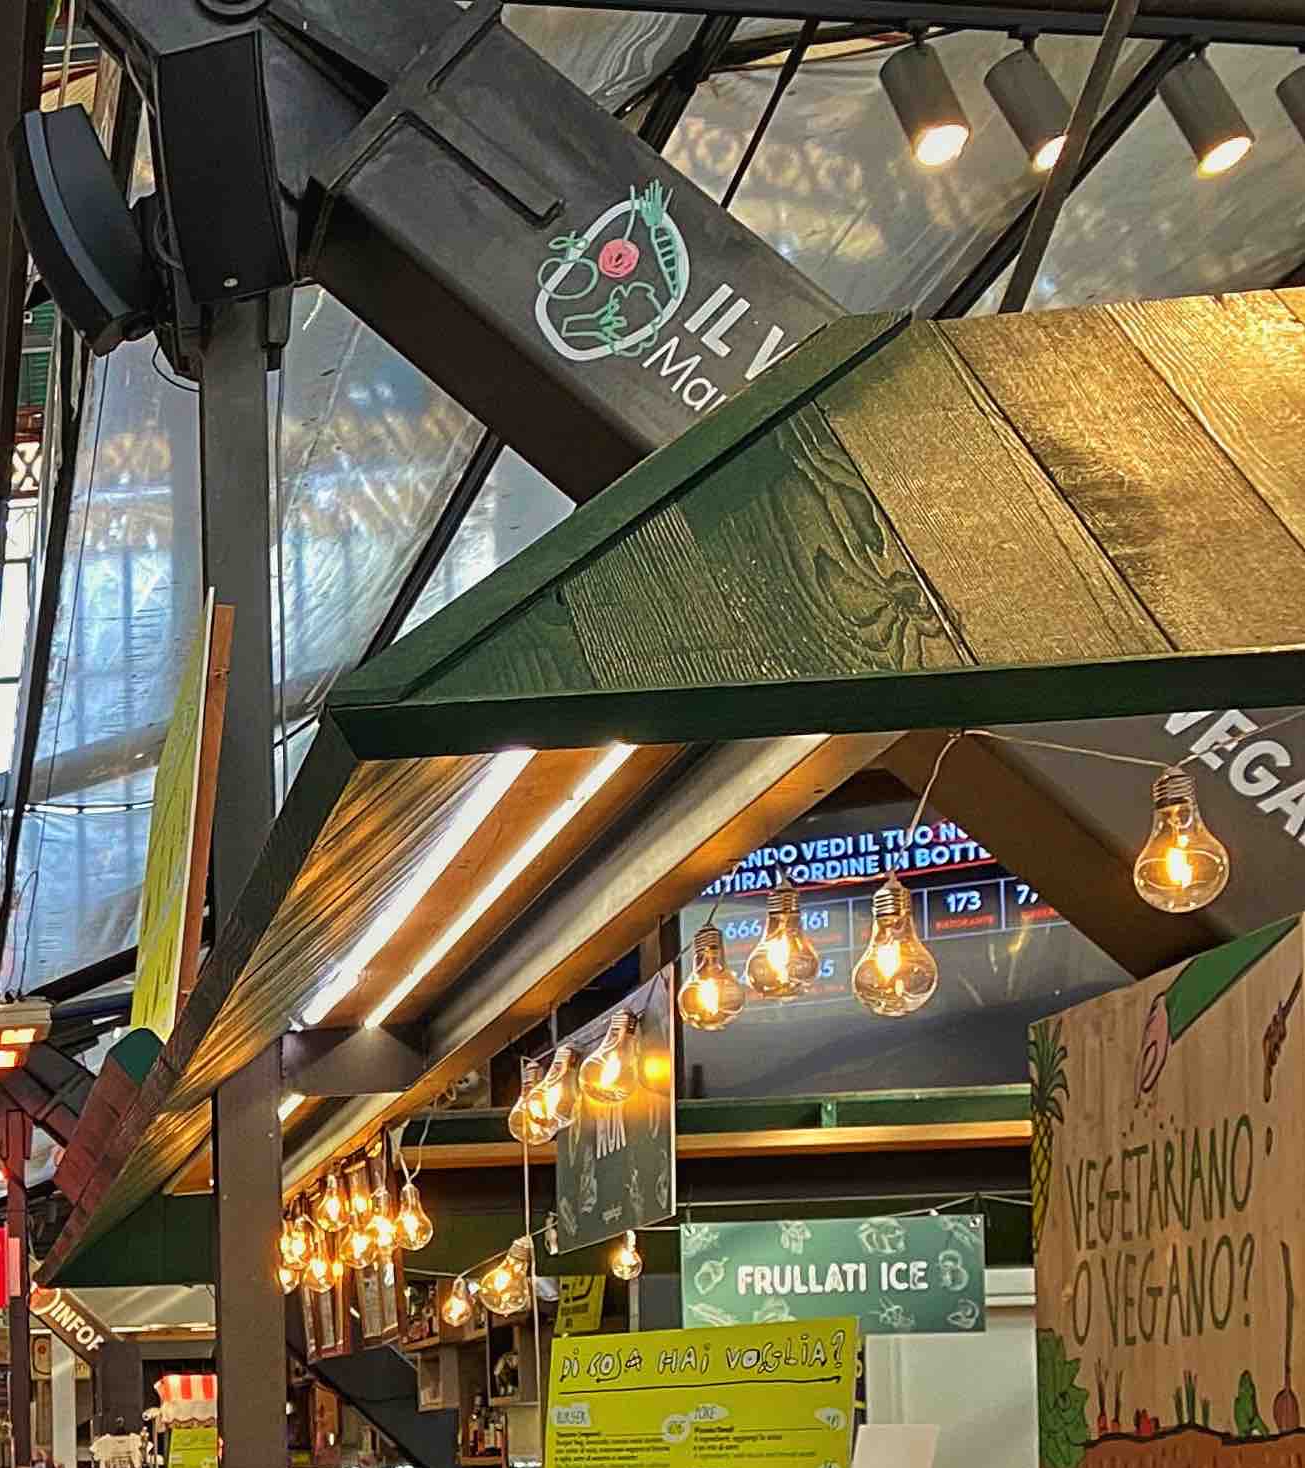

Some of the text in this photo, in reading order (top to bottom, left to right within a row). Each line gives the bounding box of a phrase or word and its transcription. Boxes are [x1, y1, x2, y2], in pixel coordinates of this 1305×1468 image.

[684, 283, 751, 358] IL
[801, 836, 853, 861] VEDI
[861, 833, 880, 853] IL
[883, 824, 935, 848] TUO
[885, 851, 910, 871] IN
[946, 890, 982, 913] 173
[1065, 1113, 1254, 1251] VEGETARIANO
[737, 1260, 929, 1296] FRULLATI ICE
[1072, 1232, 1255, 1348] O VEGANO?
